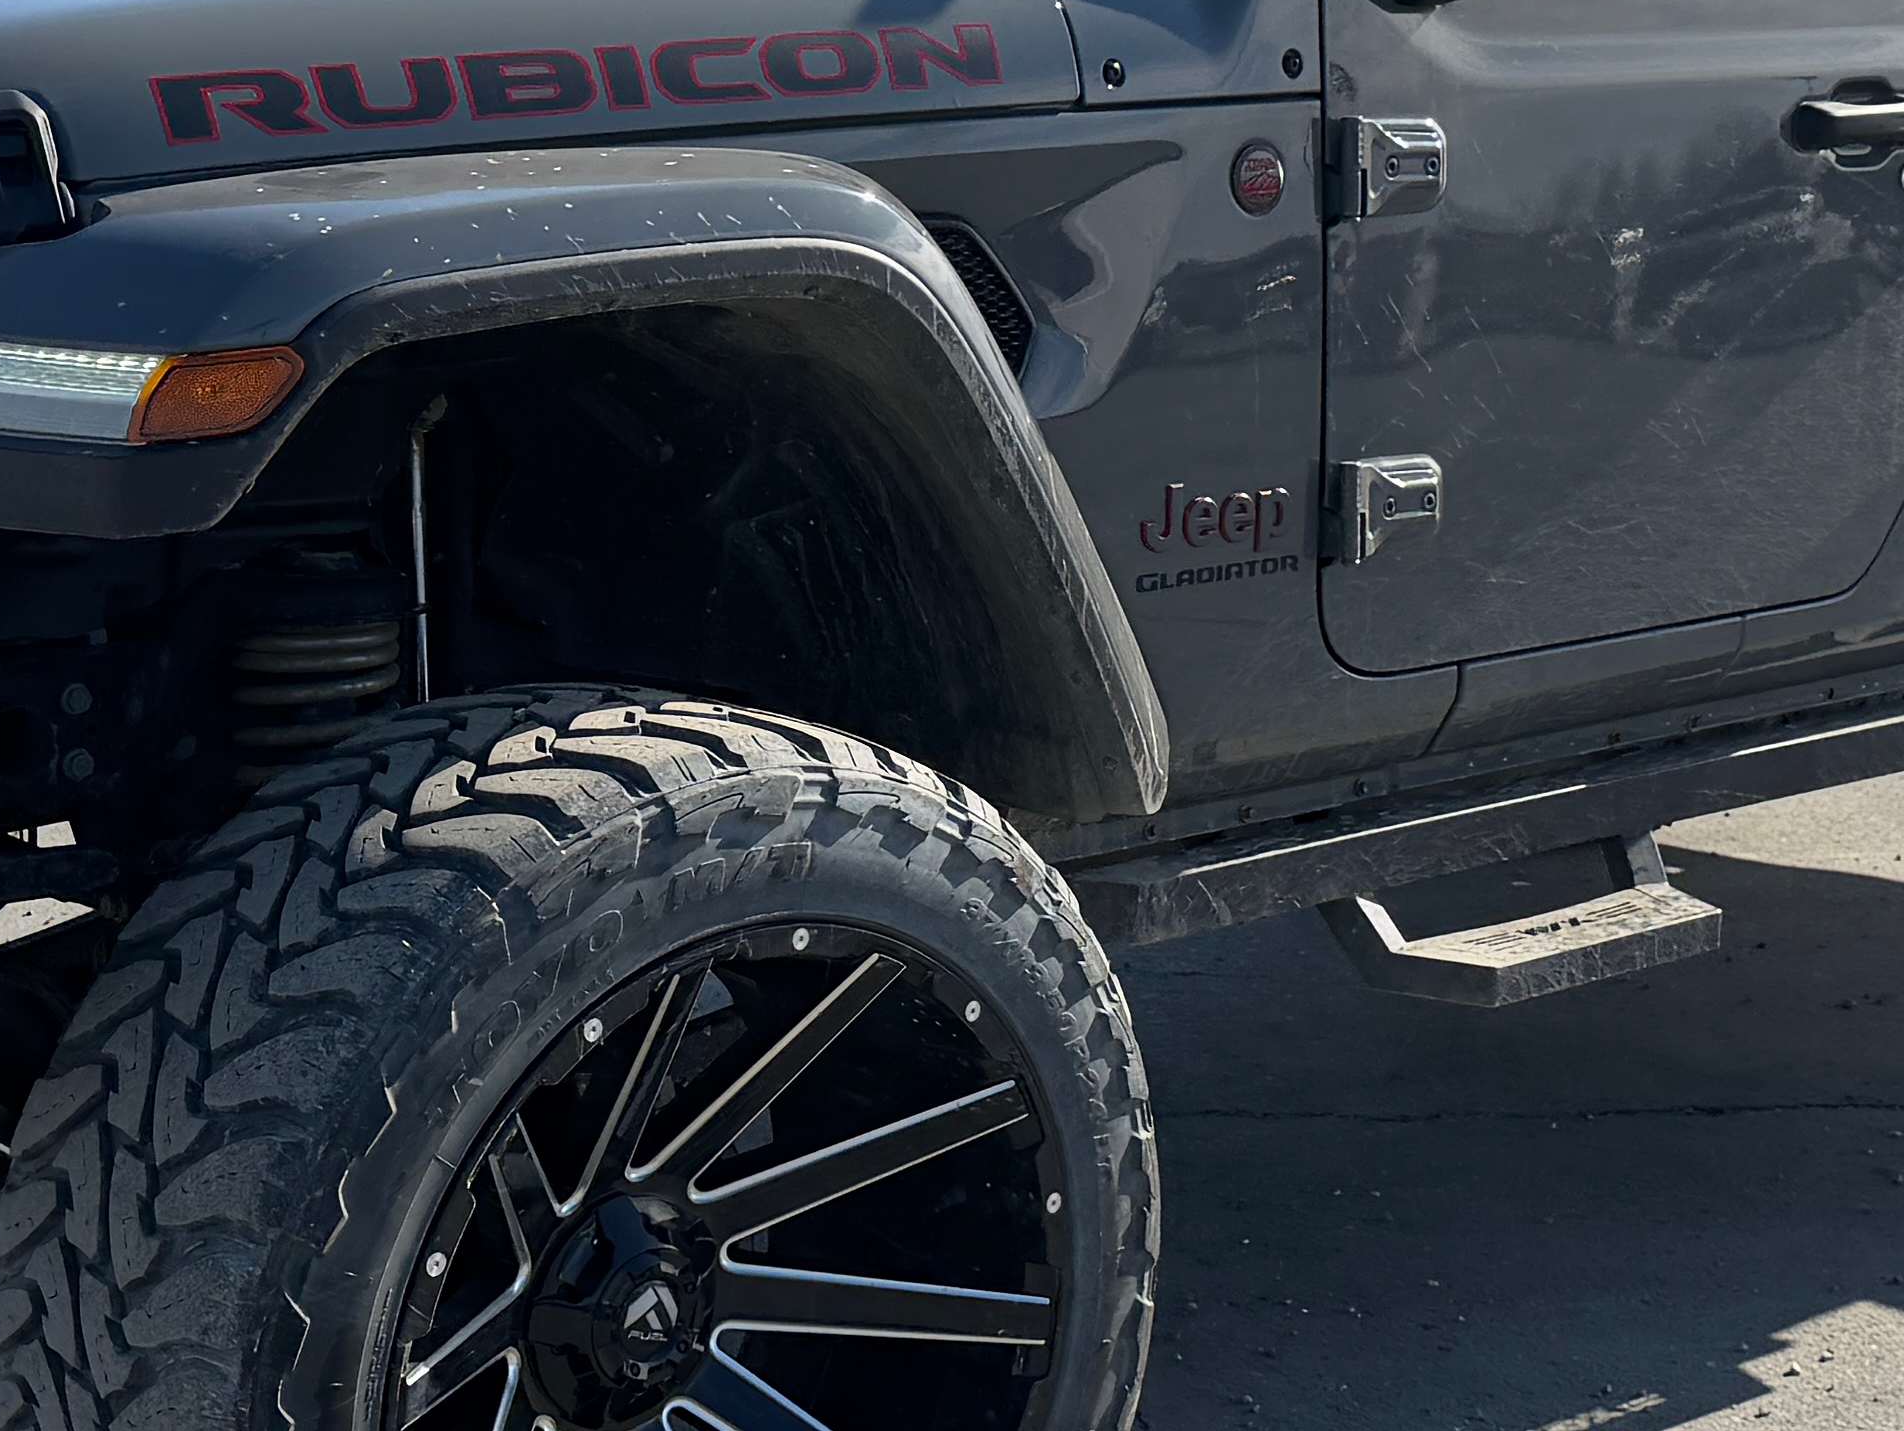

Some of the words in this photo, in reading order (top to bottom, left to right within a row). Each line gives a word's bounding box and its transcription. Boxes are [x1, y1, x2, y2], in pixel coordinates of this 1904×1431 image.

[149, 23, 1005, 147] RUBICON
[1139, 482, 1290, 554] Jeep
[1135, 555, 1299, 594] GLADIATOR
[627, 1329, 669, 1342] FUEL
